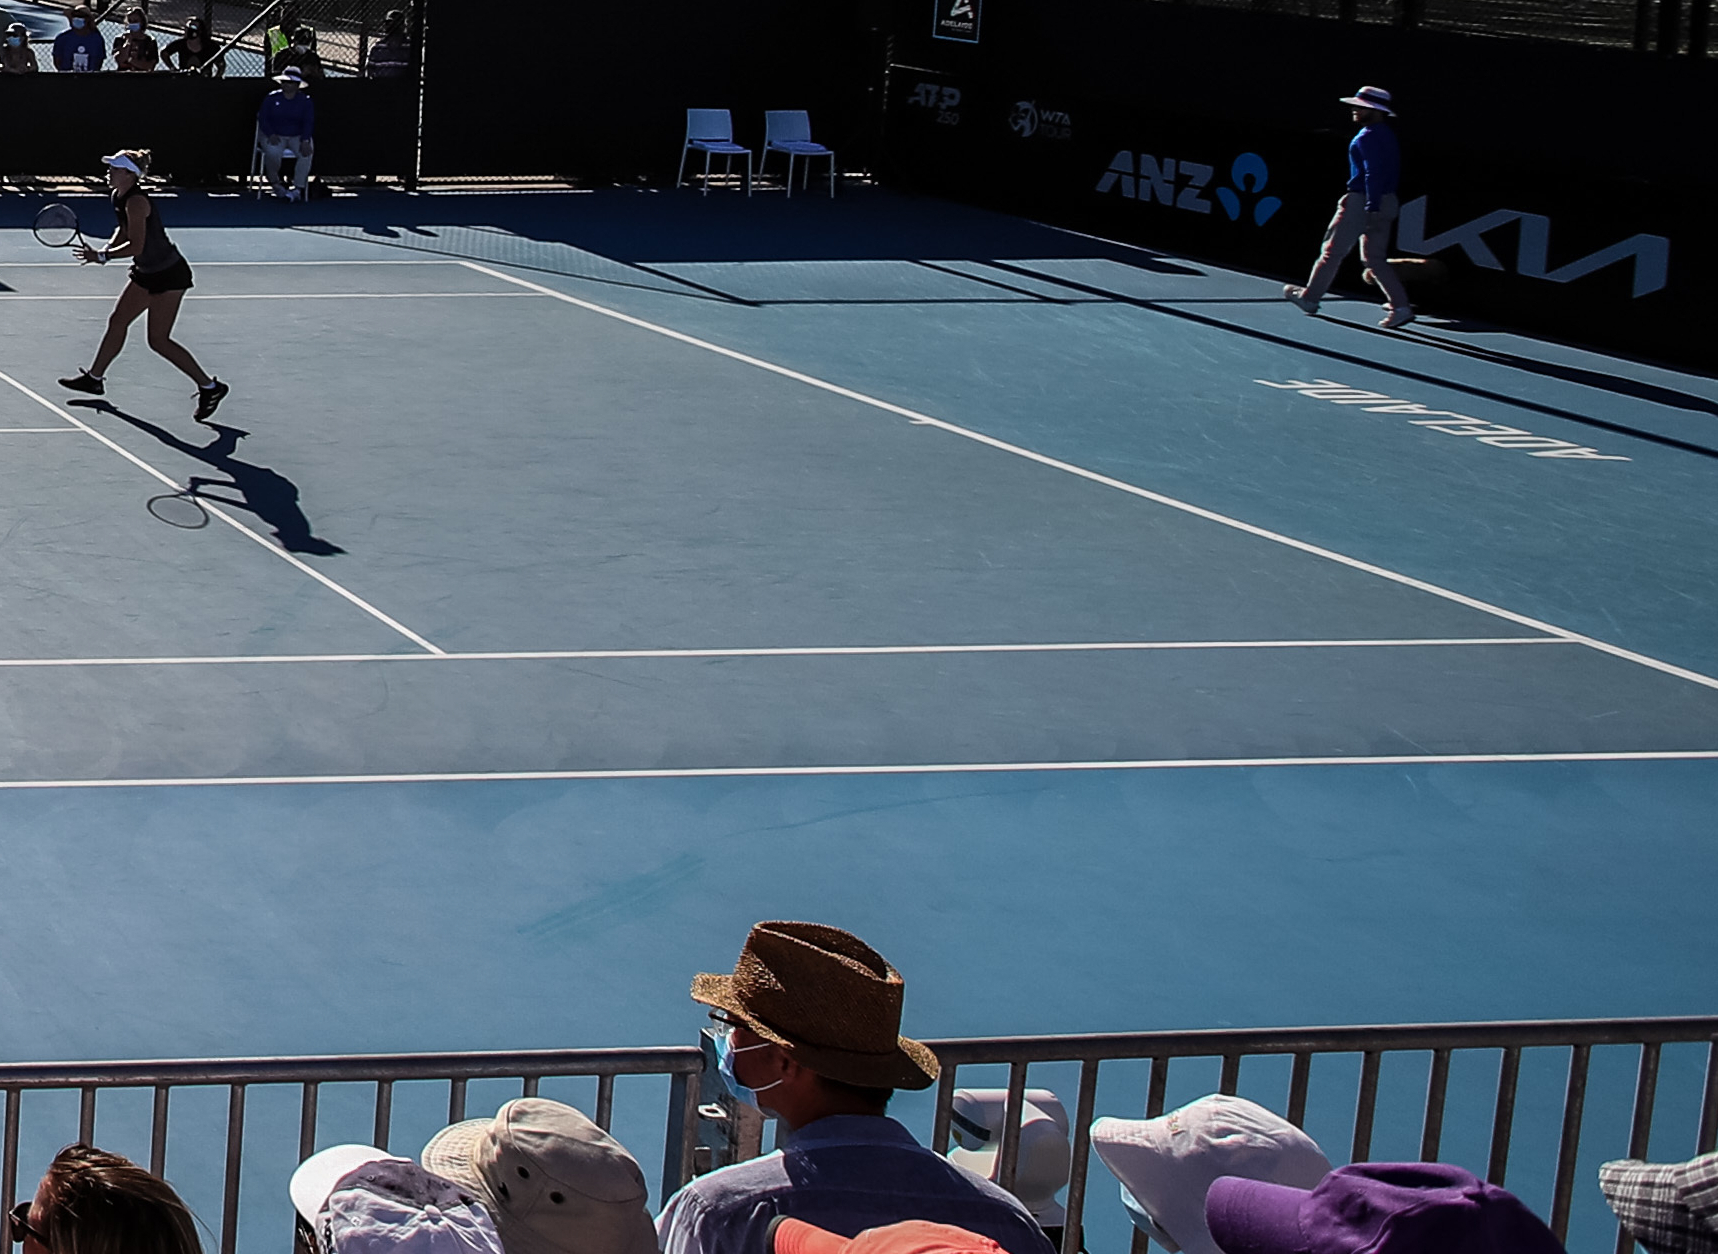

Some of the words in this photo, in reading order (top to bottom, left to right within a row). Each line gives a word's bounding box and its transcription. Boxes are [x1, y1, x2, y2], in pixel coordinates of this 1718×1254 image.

[907, 82, 962, 109] ATP
[936, 110, 960, 126] 250
[1040, 109, 1071, 125] WTA
[1094, 149, 1214, 214] ANZ
[1252, 378, 1633, 461] ADELAIDE
